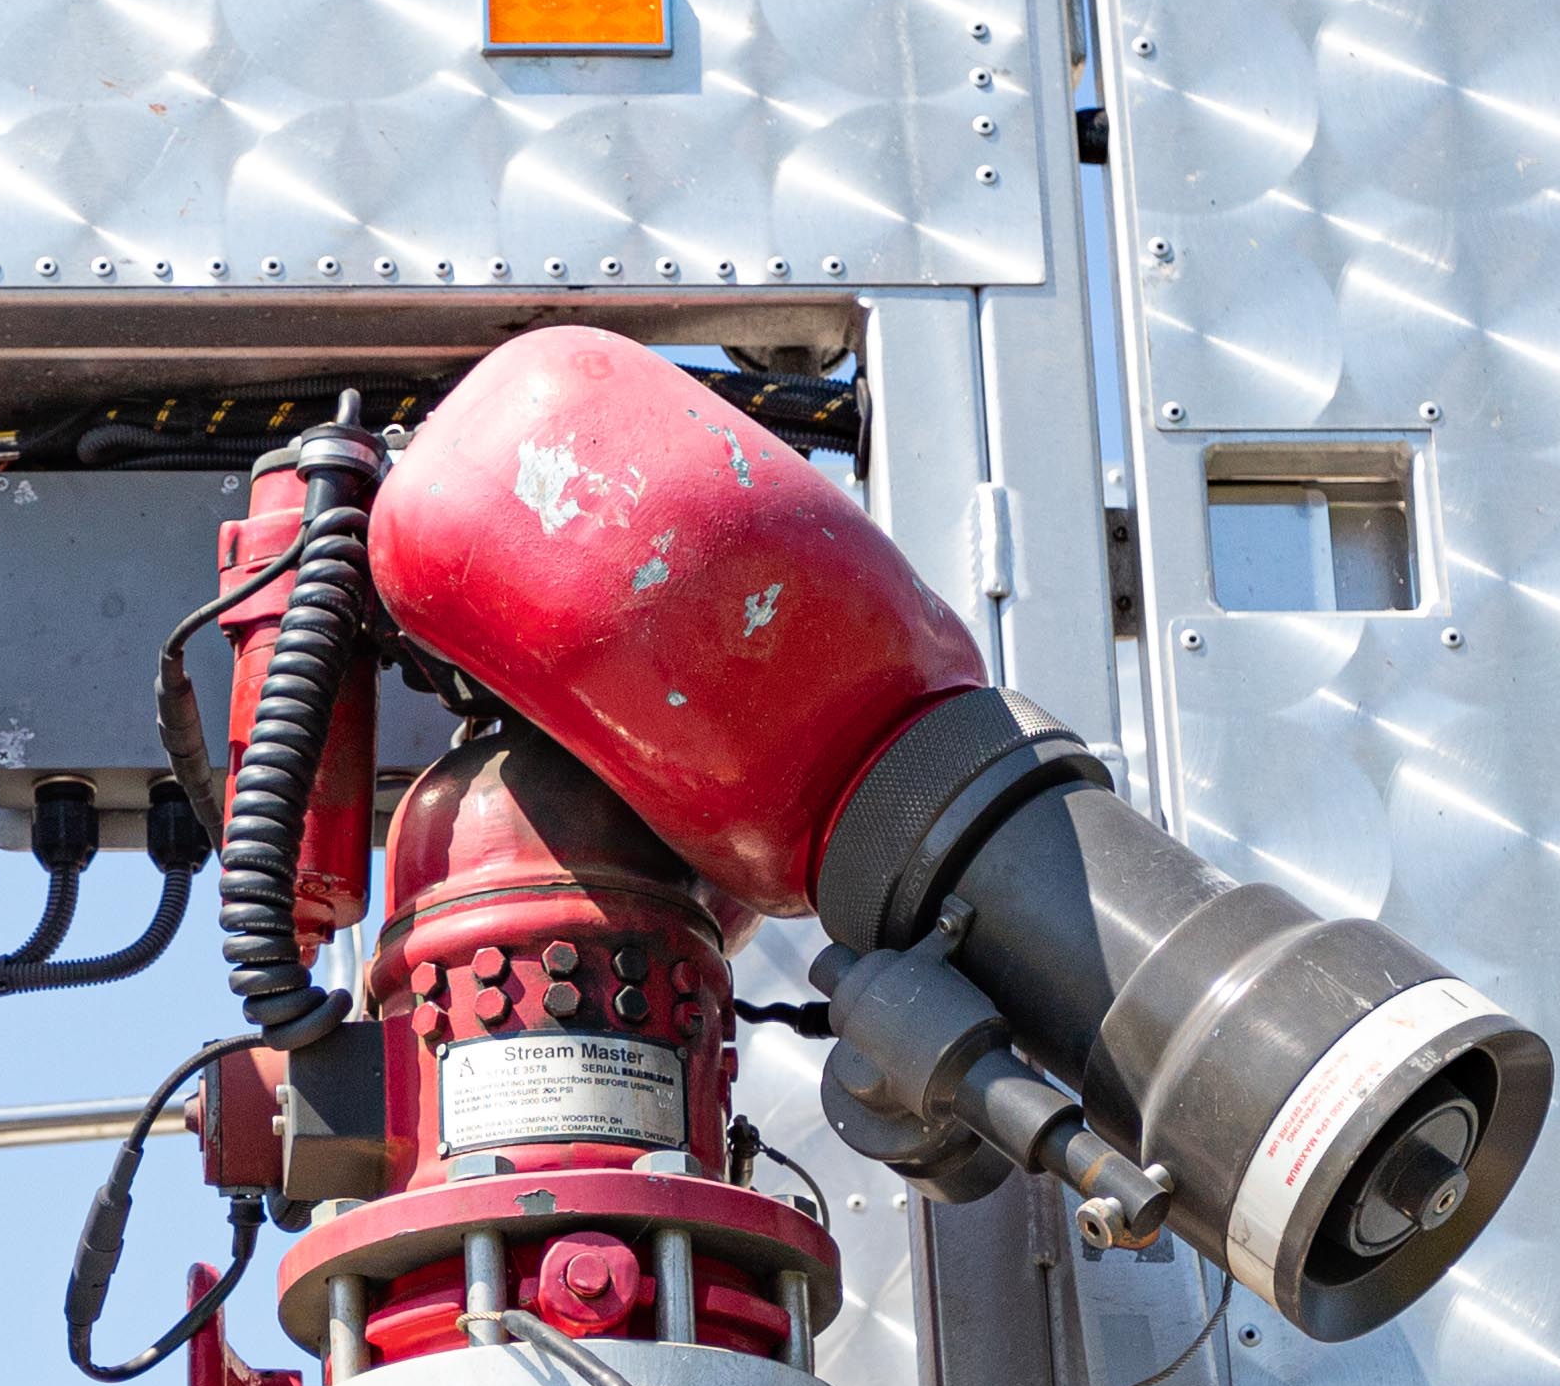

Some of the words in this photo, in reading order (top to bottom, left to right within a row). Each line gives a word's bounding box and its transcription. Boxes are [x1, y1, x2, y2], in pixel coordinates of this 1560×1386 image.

[504, 1045, 574, 1062] Stream
[581, 1043, 644, 1065] Master
[524, 1065, 548, 1075] 3578
[581, 1063, 620, 1075] SERIAL
[527, 1075, 592, 1086] INSTRUCTIONS
[594, 1077, 629, 1088] BEFORE
[630, 1081, 654, 1093] USING
[559, 1086, 574, 1094] PSI
[520, 1098, 540, 1106] 2000
[541, 1096, 562, 1104] GPM
[562, 1114, 609, 1124] WOOSTER,
[609, 1116, 623, 1125] OH
[1279, 1105, 1303, 1141] BEFORE
[1286, 1095, 1322, 1144] OPERATING
[485, 1124, 560, 1137] MANUFACTURING
[644, 1131, 679, 1145] ONTARIO
[1267, 1140, 1281, 1159] USE
[1285, 1136, 1319, 1187] MAXIMUM
